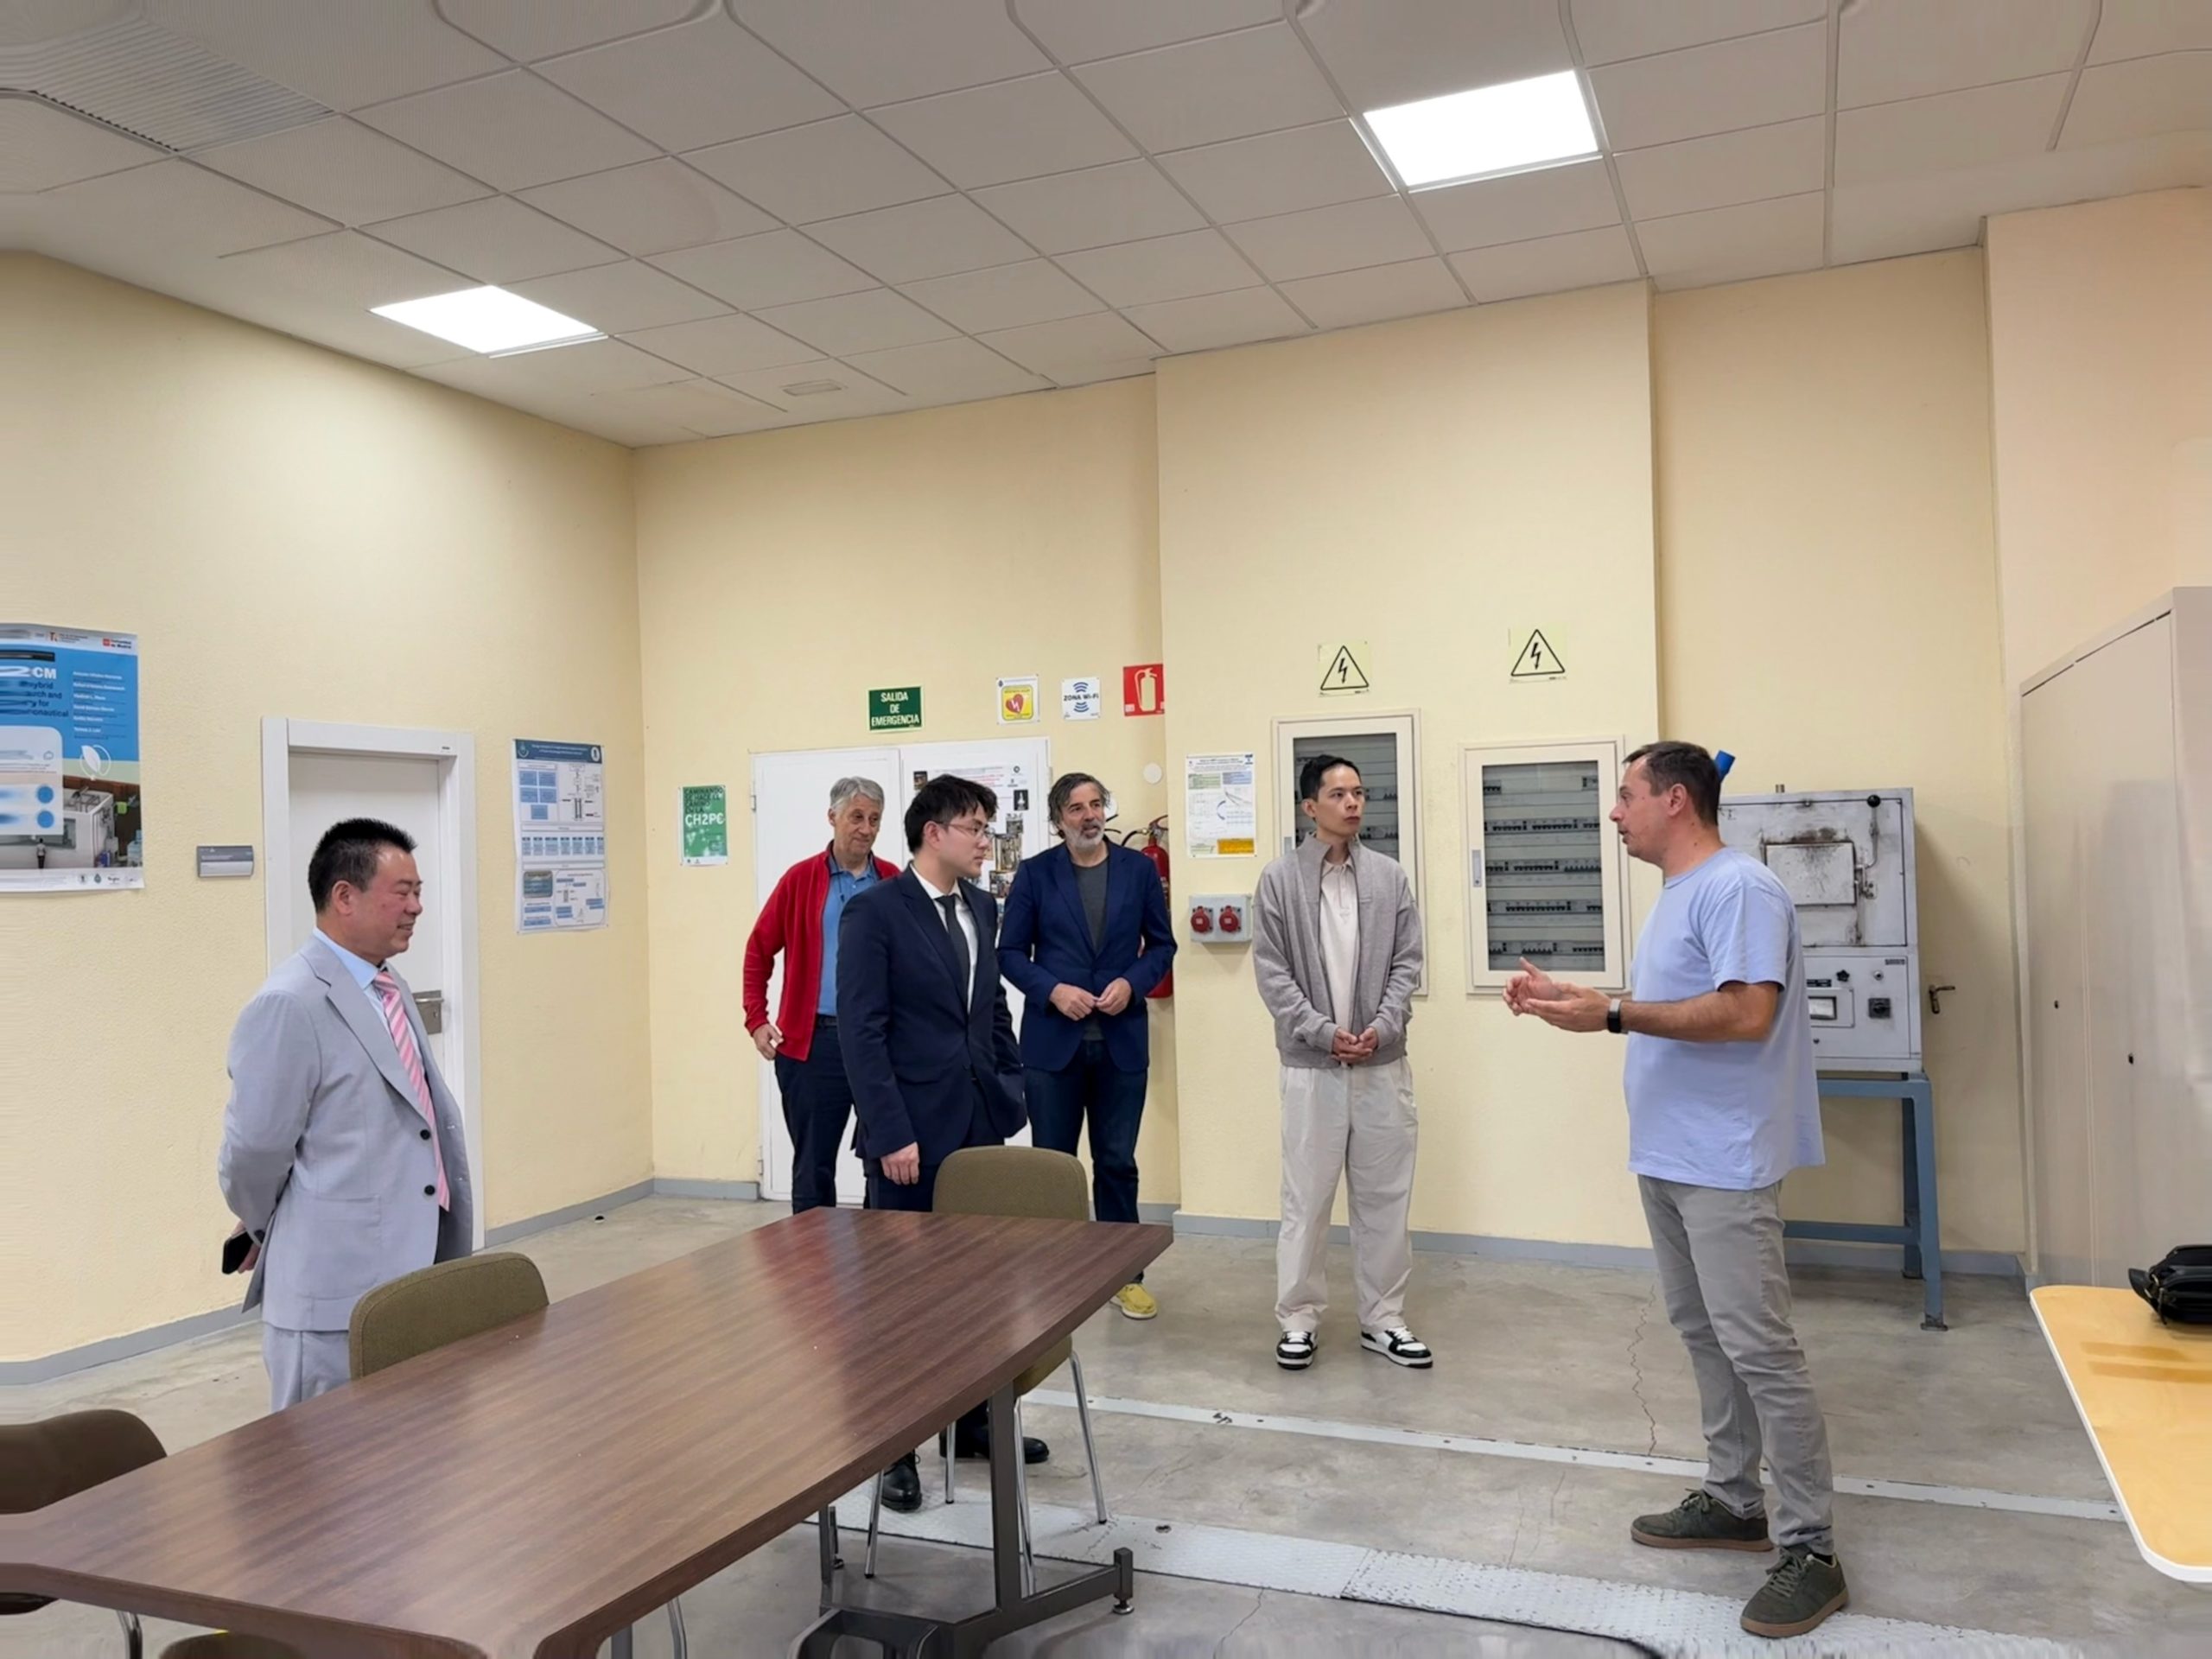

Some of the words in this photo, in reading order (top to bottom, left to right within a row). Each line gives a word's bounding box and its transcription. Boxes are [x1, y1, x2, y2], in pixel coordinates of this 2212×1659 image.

[880, 691, 909, 702] SALIDA
[890, 703, 900, 714] DE
[871, 714, 920, 727] EMERGENCIA
